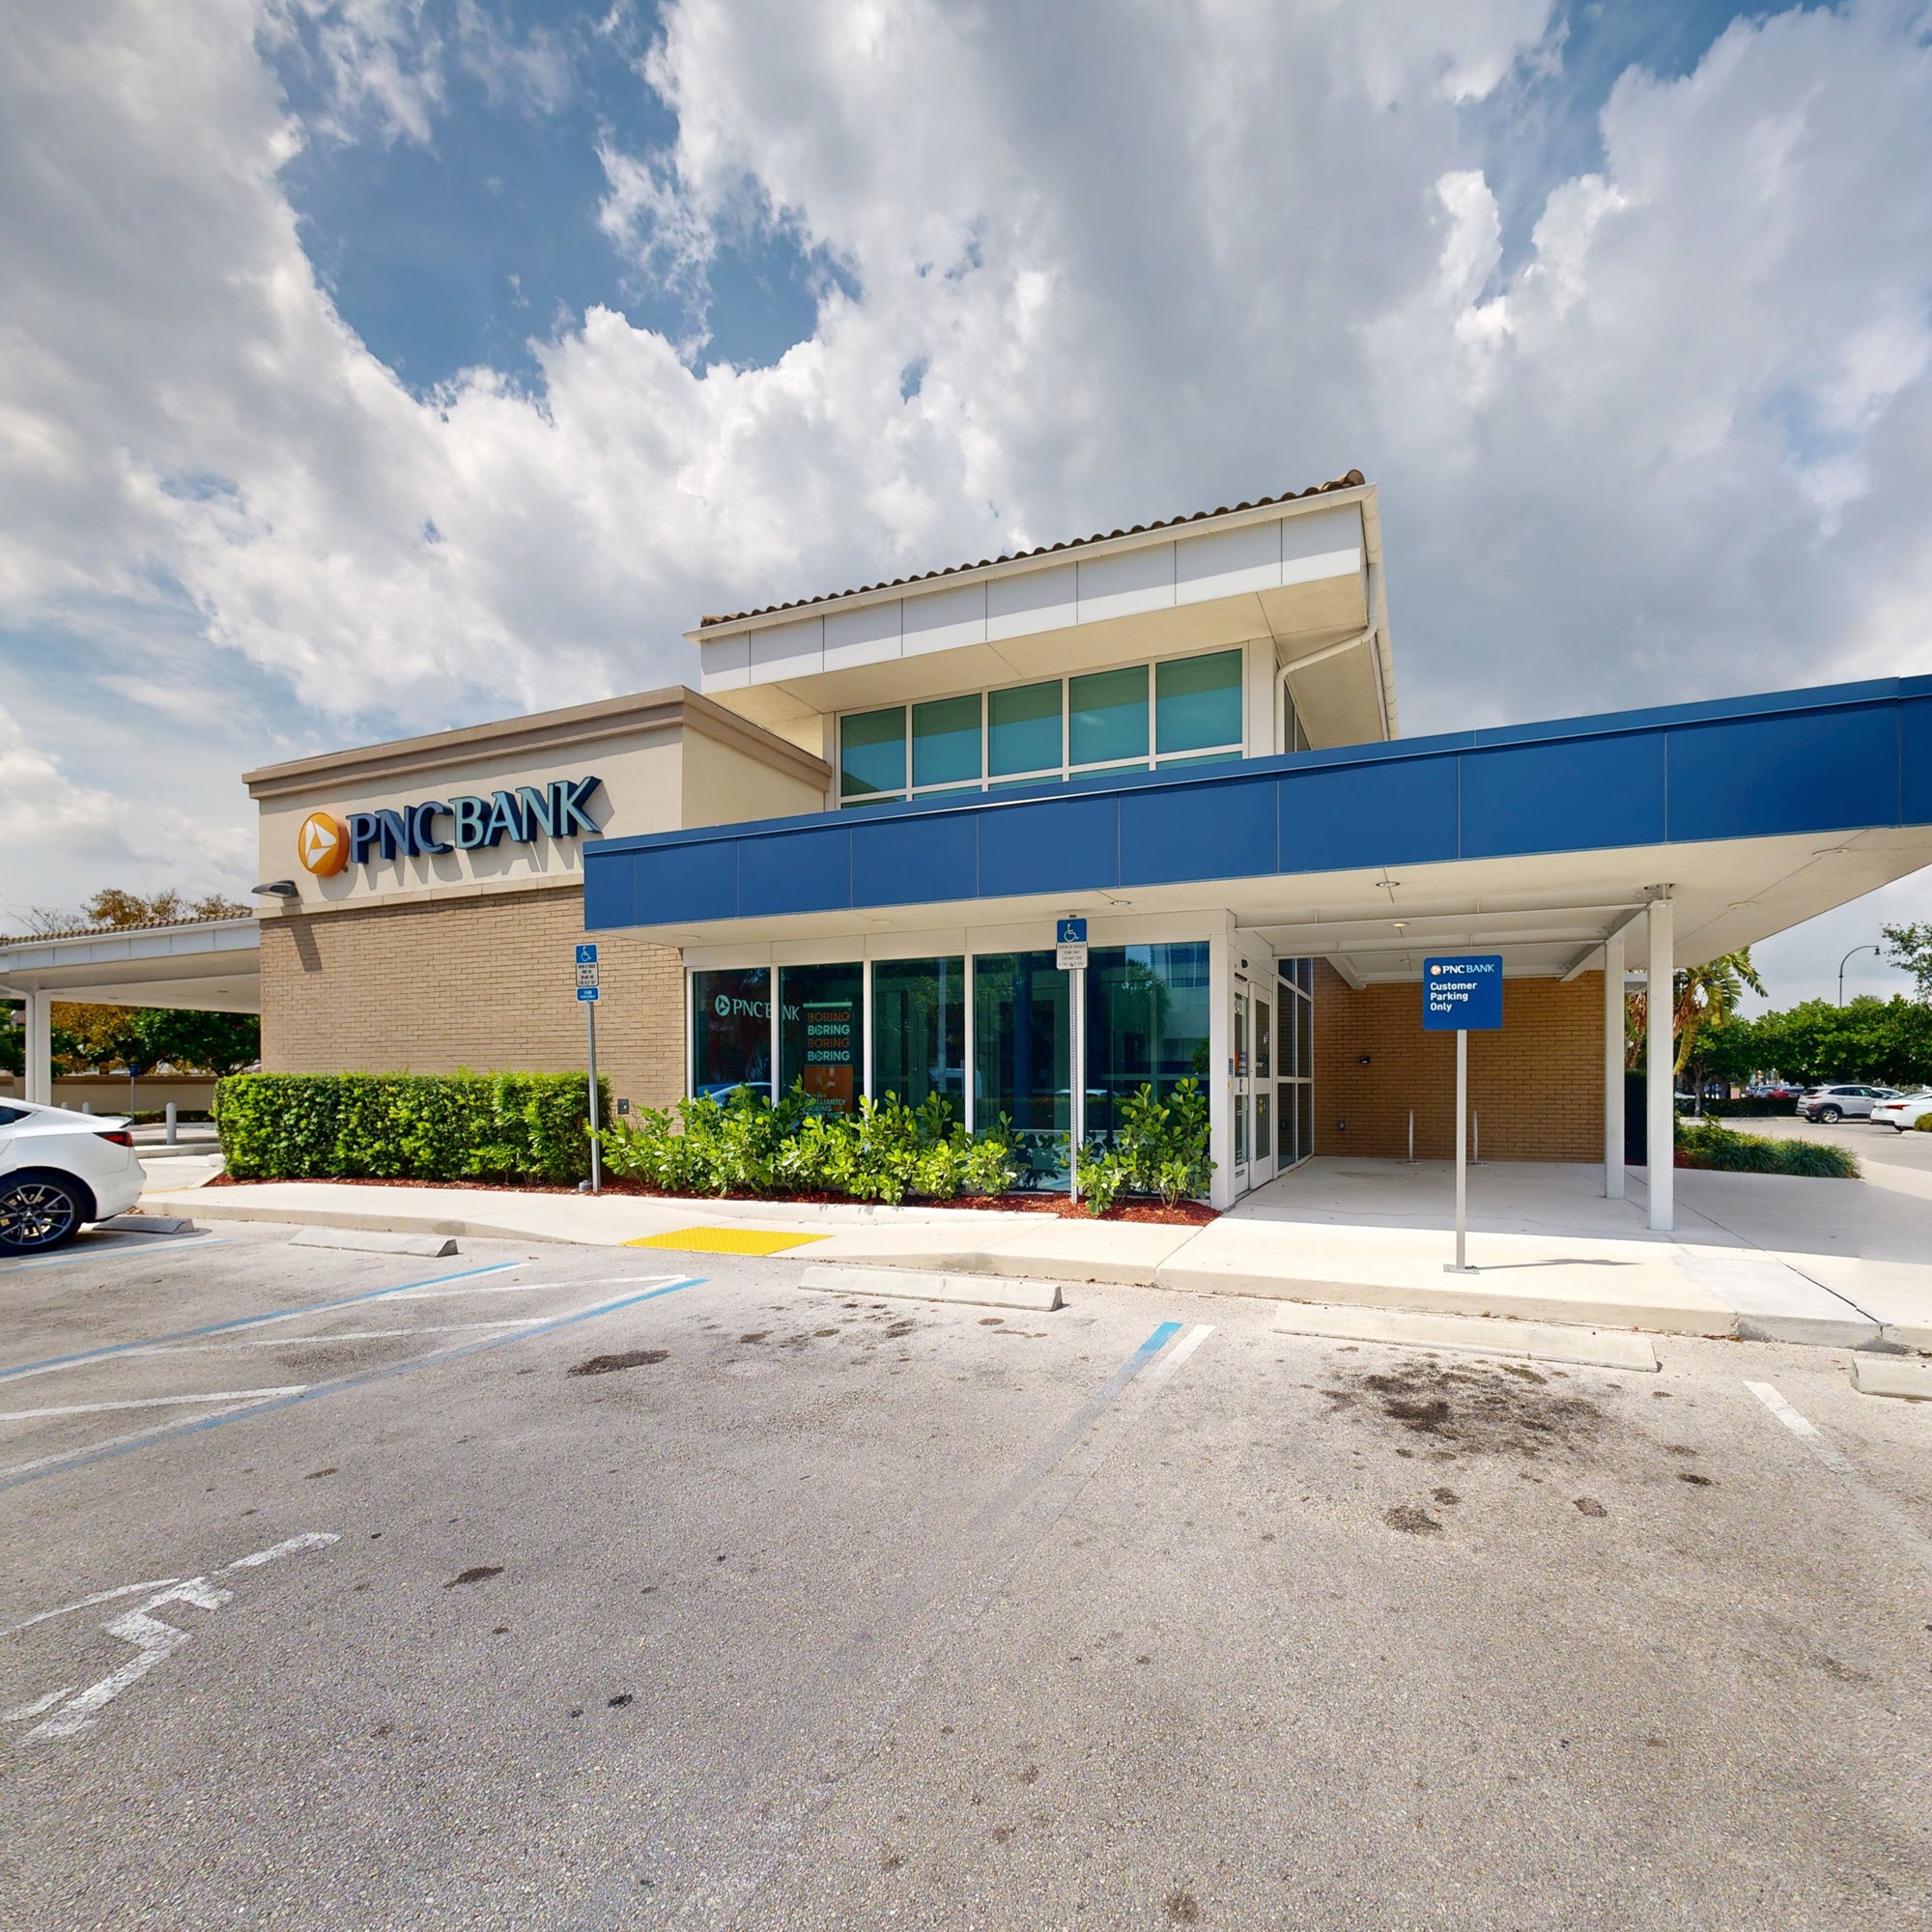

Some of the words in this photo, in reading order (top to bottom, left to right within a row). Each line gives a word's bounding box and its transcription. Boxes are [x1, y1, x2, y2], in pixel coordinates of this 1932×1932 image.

[346, 800, 454, 864] PNC
[448, 776, 603, 850] BANK
[1442, 965, 1465, 975] PNC
[1465, 964, 1494, 973] BANK
[1430, 981, 1477, 991] Customer
[1430, 992, 1468, 1002] Parking
[731, 998, 763, 1018] PNC
[764, 1002, 801, 1021] BNK
[1430, 1002, 1452, 1012] Only
[808, 1011, 850, 1022] BORING
[808, 1024, 850, 1036] BORING
[808, 1037, 850, 1048] BORING
[808, 1051, 850, 1062] BORING
